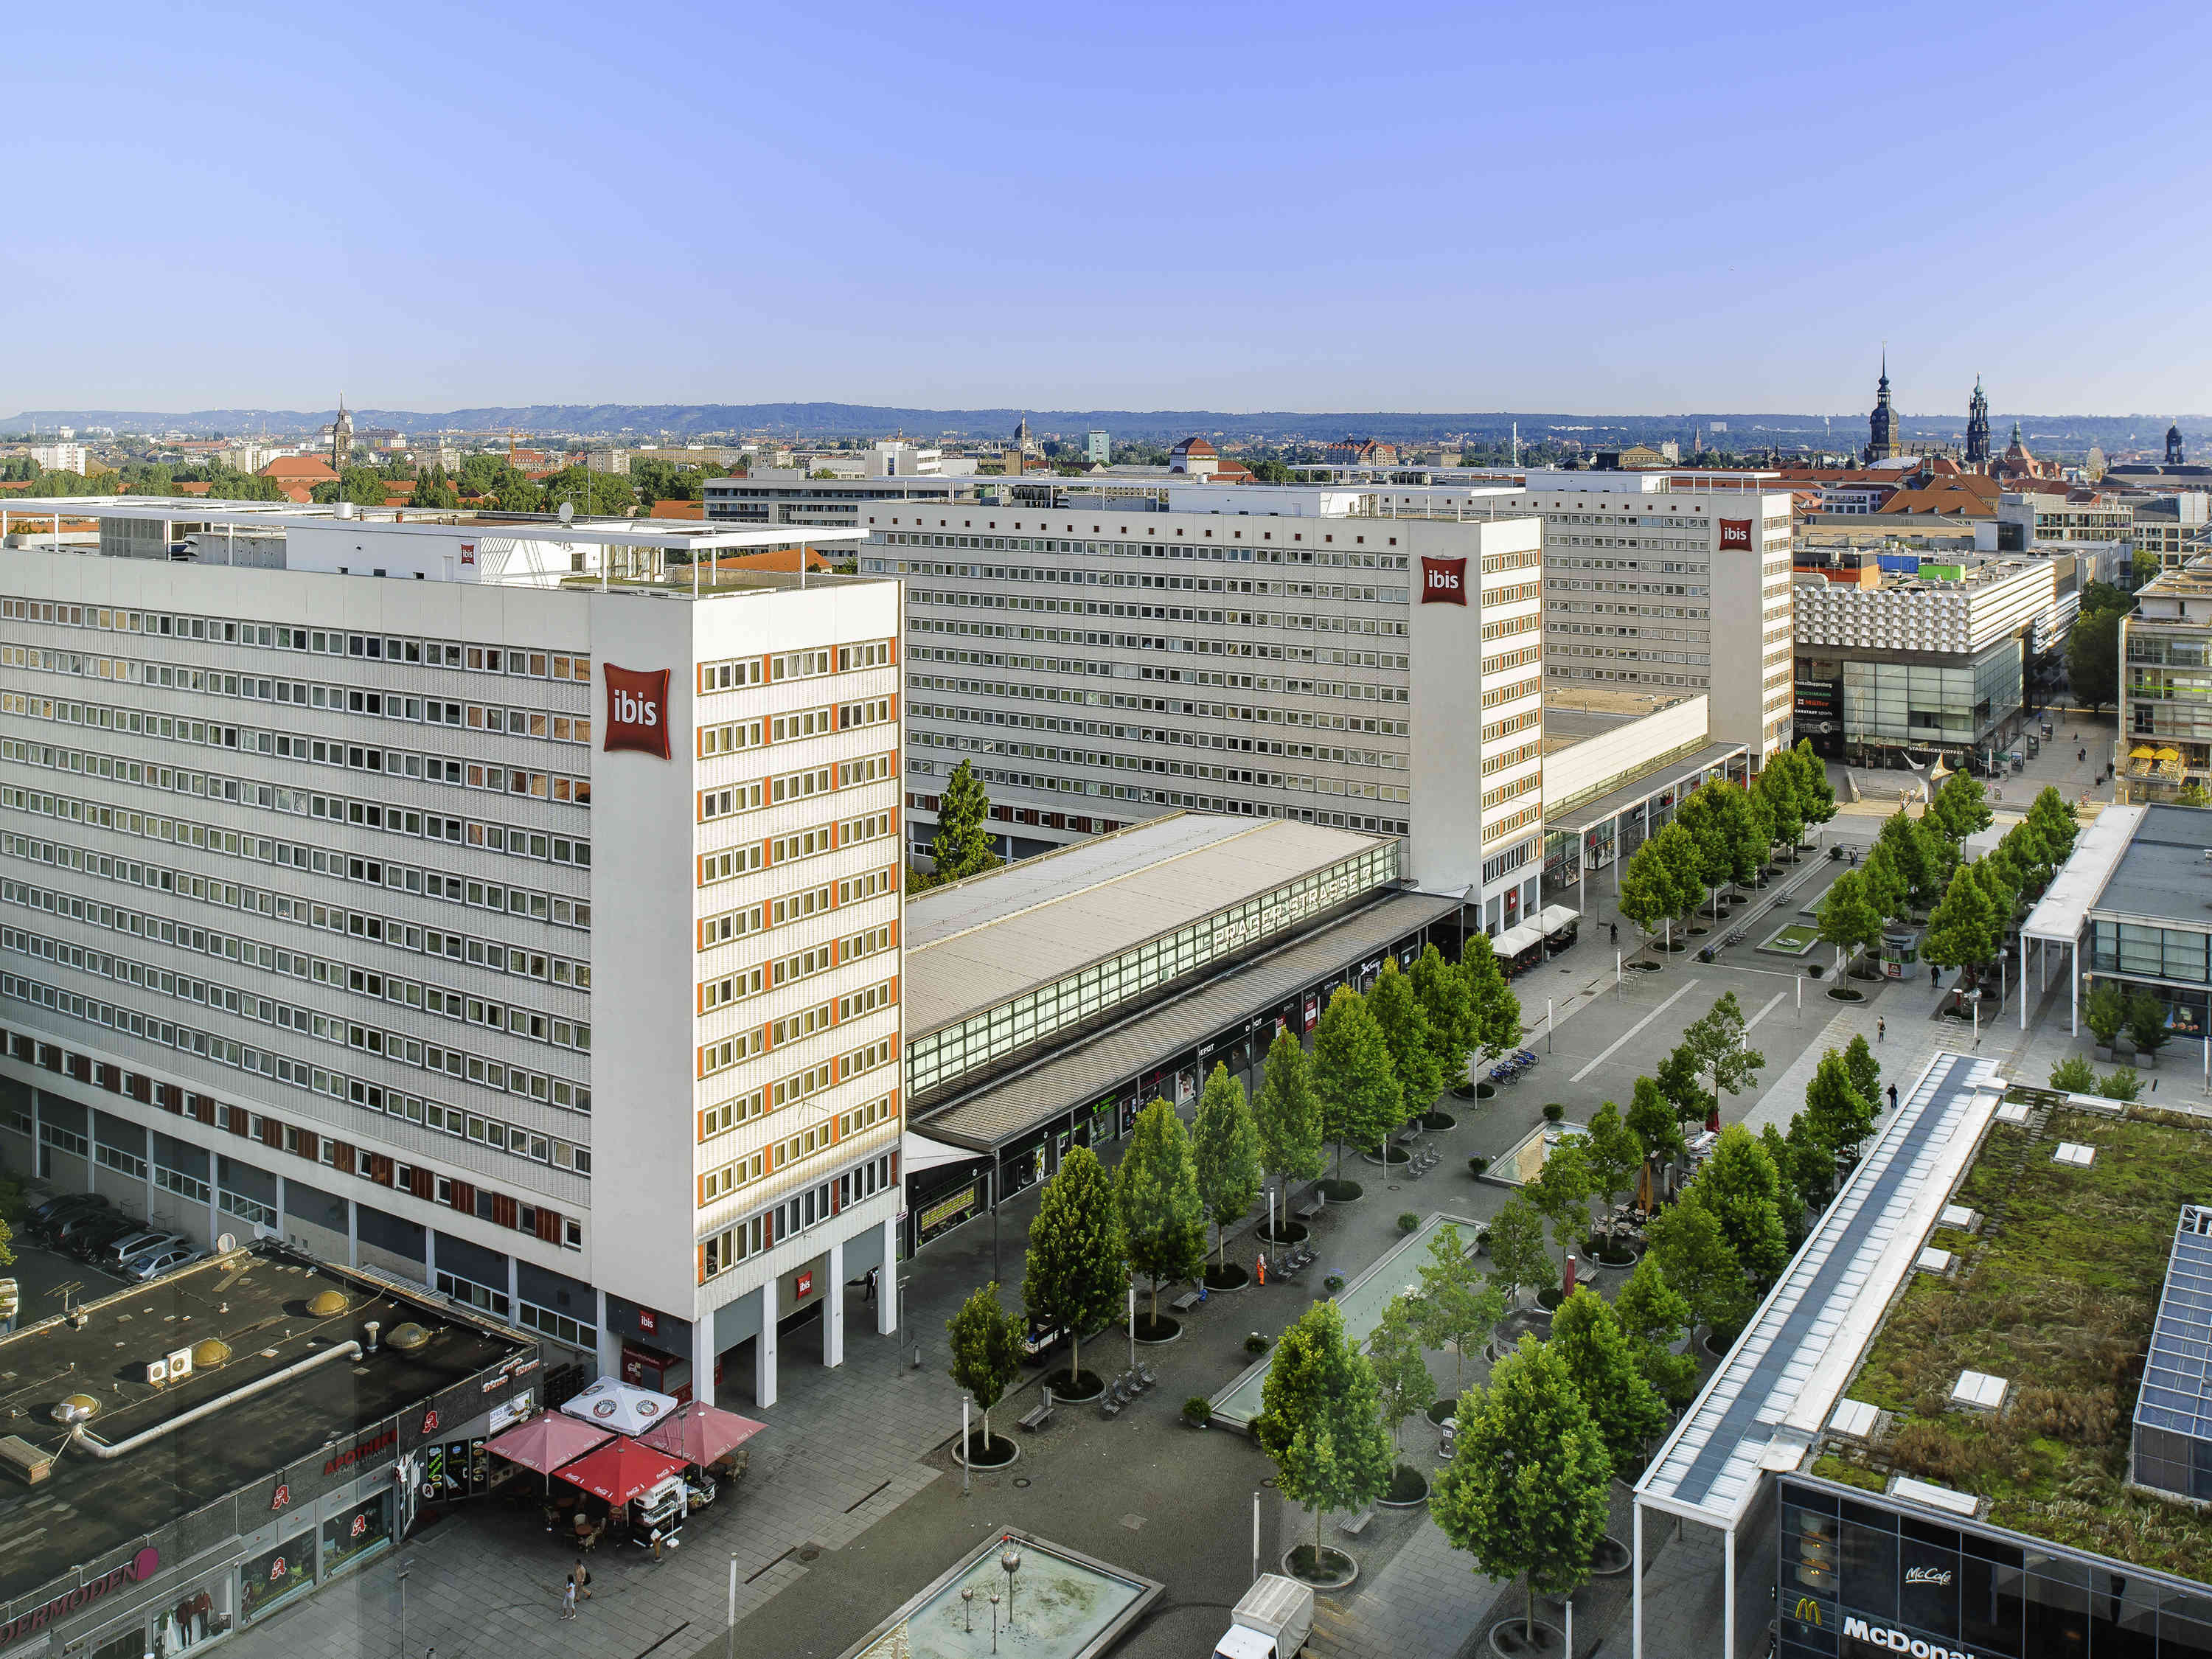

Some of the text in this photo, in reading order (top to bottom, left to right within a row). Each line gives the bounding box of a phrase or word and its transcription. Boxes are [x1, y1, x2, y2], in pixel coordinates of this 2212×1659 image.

[1724, 527, 1747, 540] ibis
[1428, 569, 1458, 588] ibis
[614, 689, 657, 726] ibis
[1214, 903, 1283, 951] PRAGER
[1289, 870, 1358, 915] STRASSE
[799, 1280, 810, 1292] ibis
[641, 1315, 653, 1328] ibis
[324, 1427, 397, 1475] APOTHEKE
[1844, 1616, 1975, 1659] McDon
